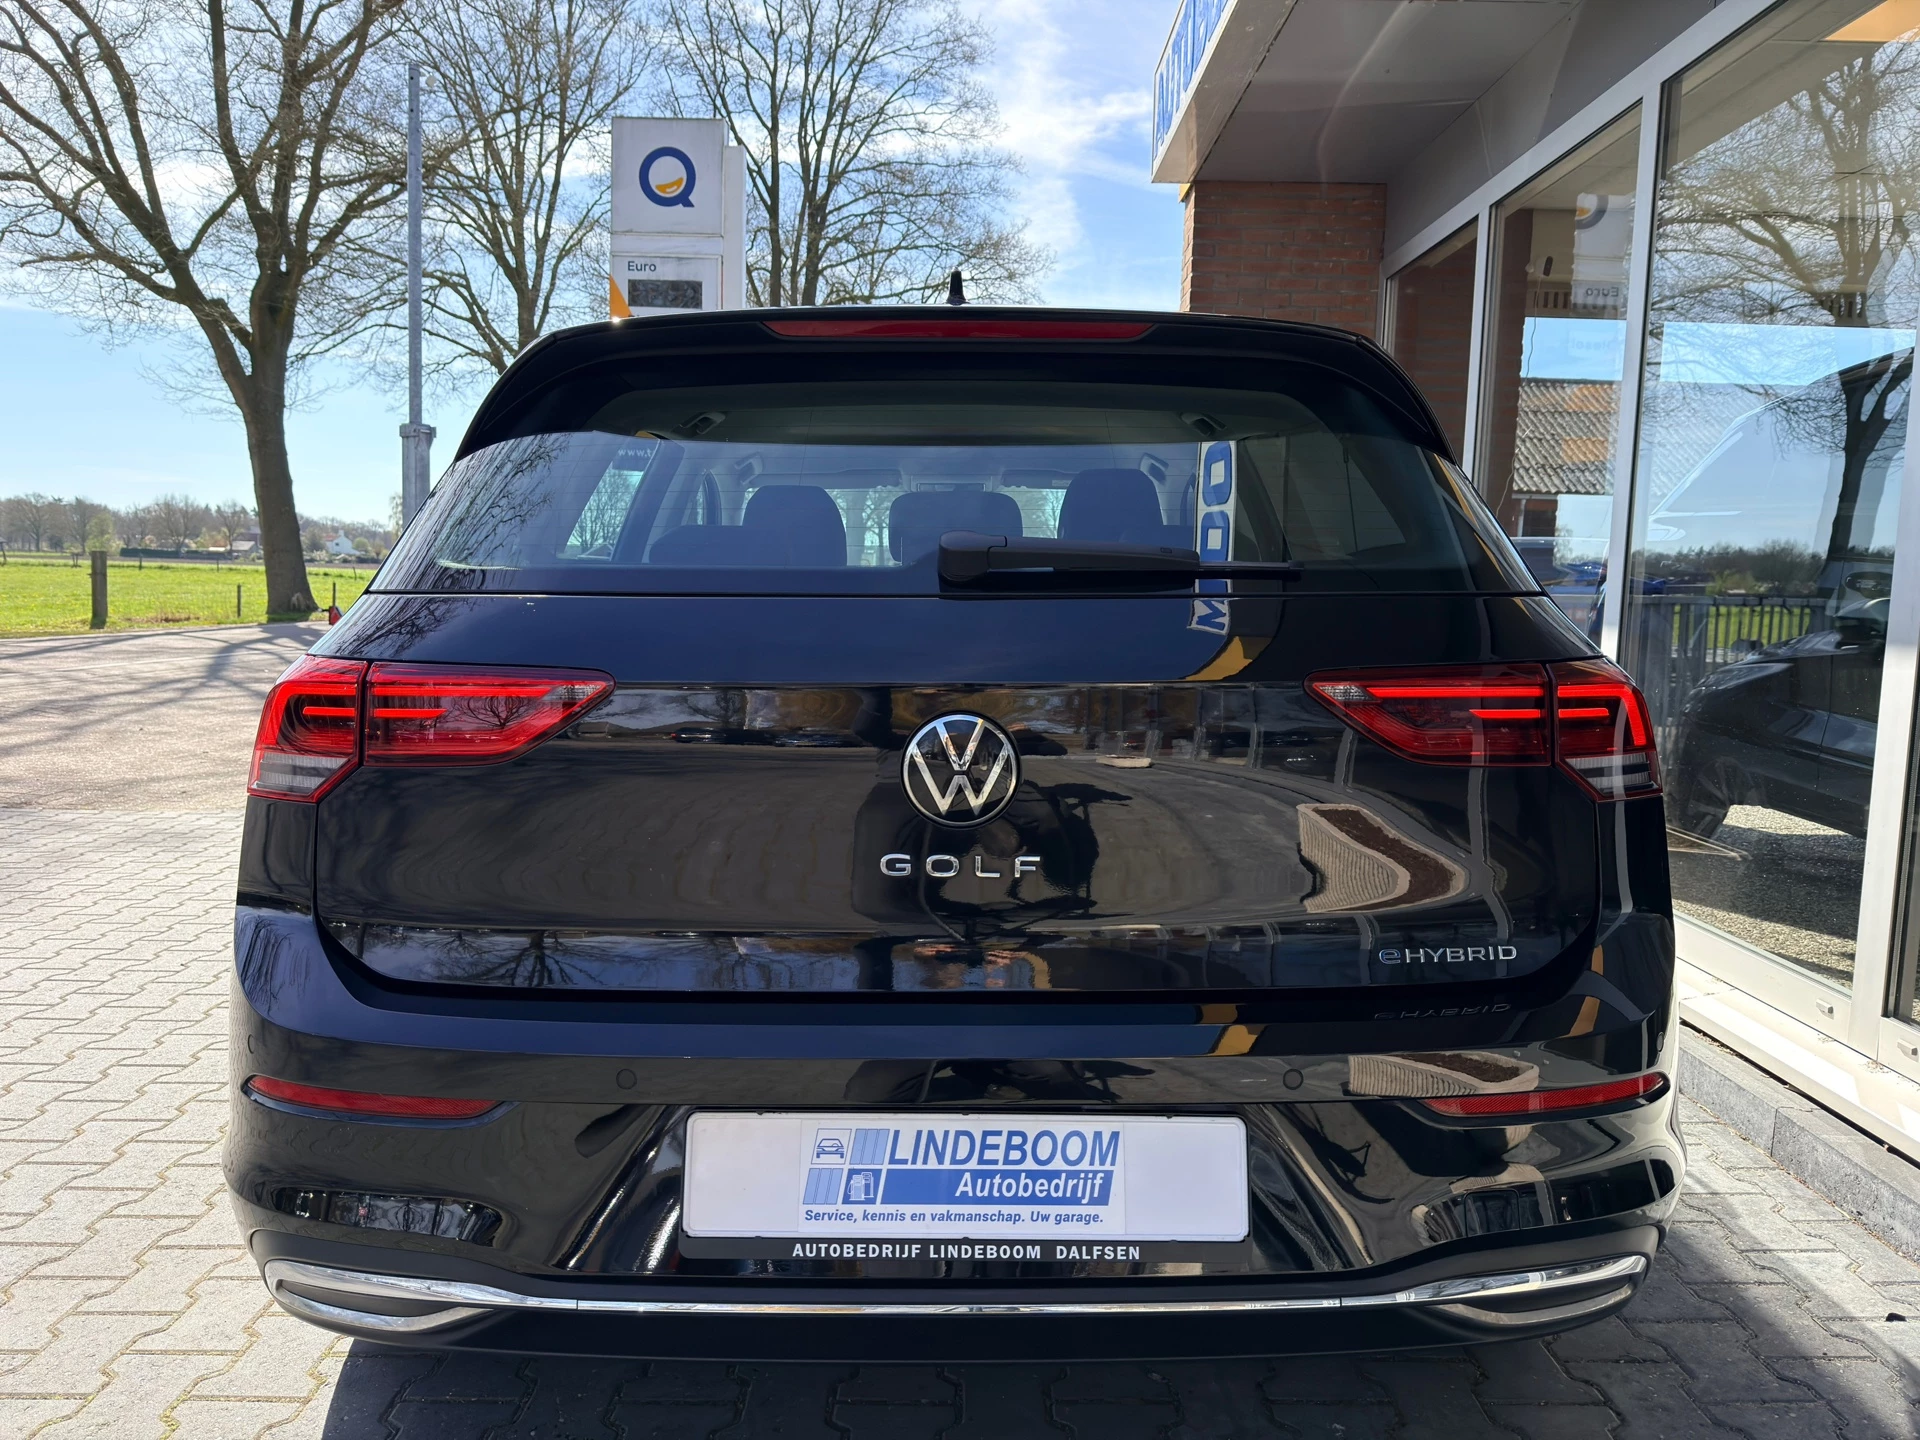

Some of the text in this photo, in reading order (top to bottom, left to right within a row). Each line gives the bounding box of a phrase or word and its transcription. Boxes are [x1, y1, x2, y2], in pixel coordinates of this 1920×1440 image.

[1153, 0, 1229, 161] AUTOB
[627, 261, 657, 272] Euro
[617, 447, 653, 458] www.t
[879, 853, 1041, 878] GOLF
[1378, 945, 1517, 965] eHYBRID
[888, 1129, 1121, 1167] LINDEBOOM
[955, 1172, 1105, 1204] Autobedrijf
[804, 1209, 1104, 1226] Service, kennis en vakmanschap. Uw garage.
[792, 1243, 1140, 1260] AUTOBEDRIJF LINDEBOOM DALFSEN
